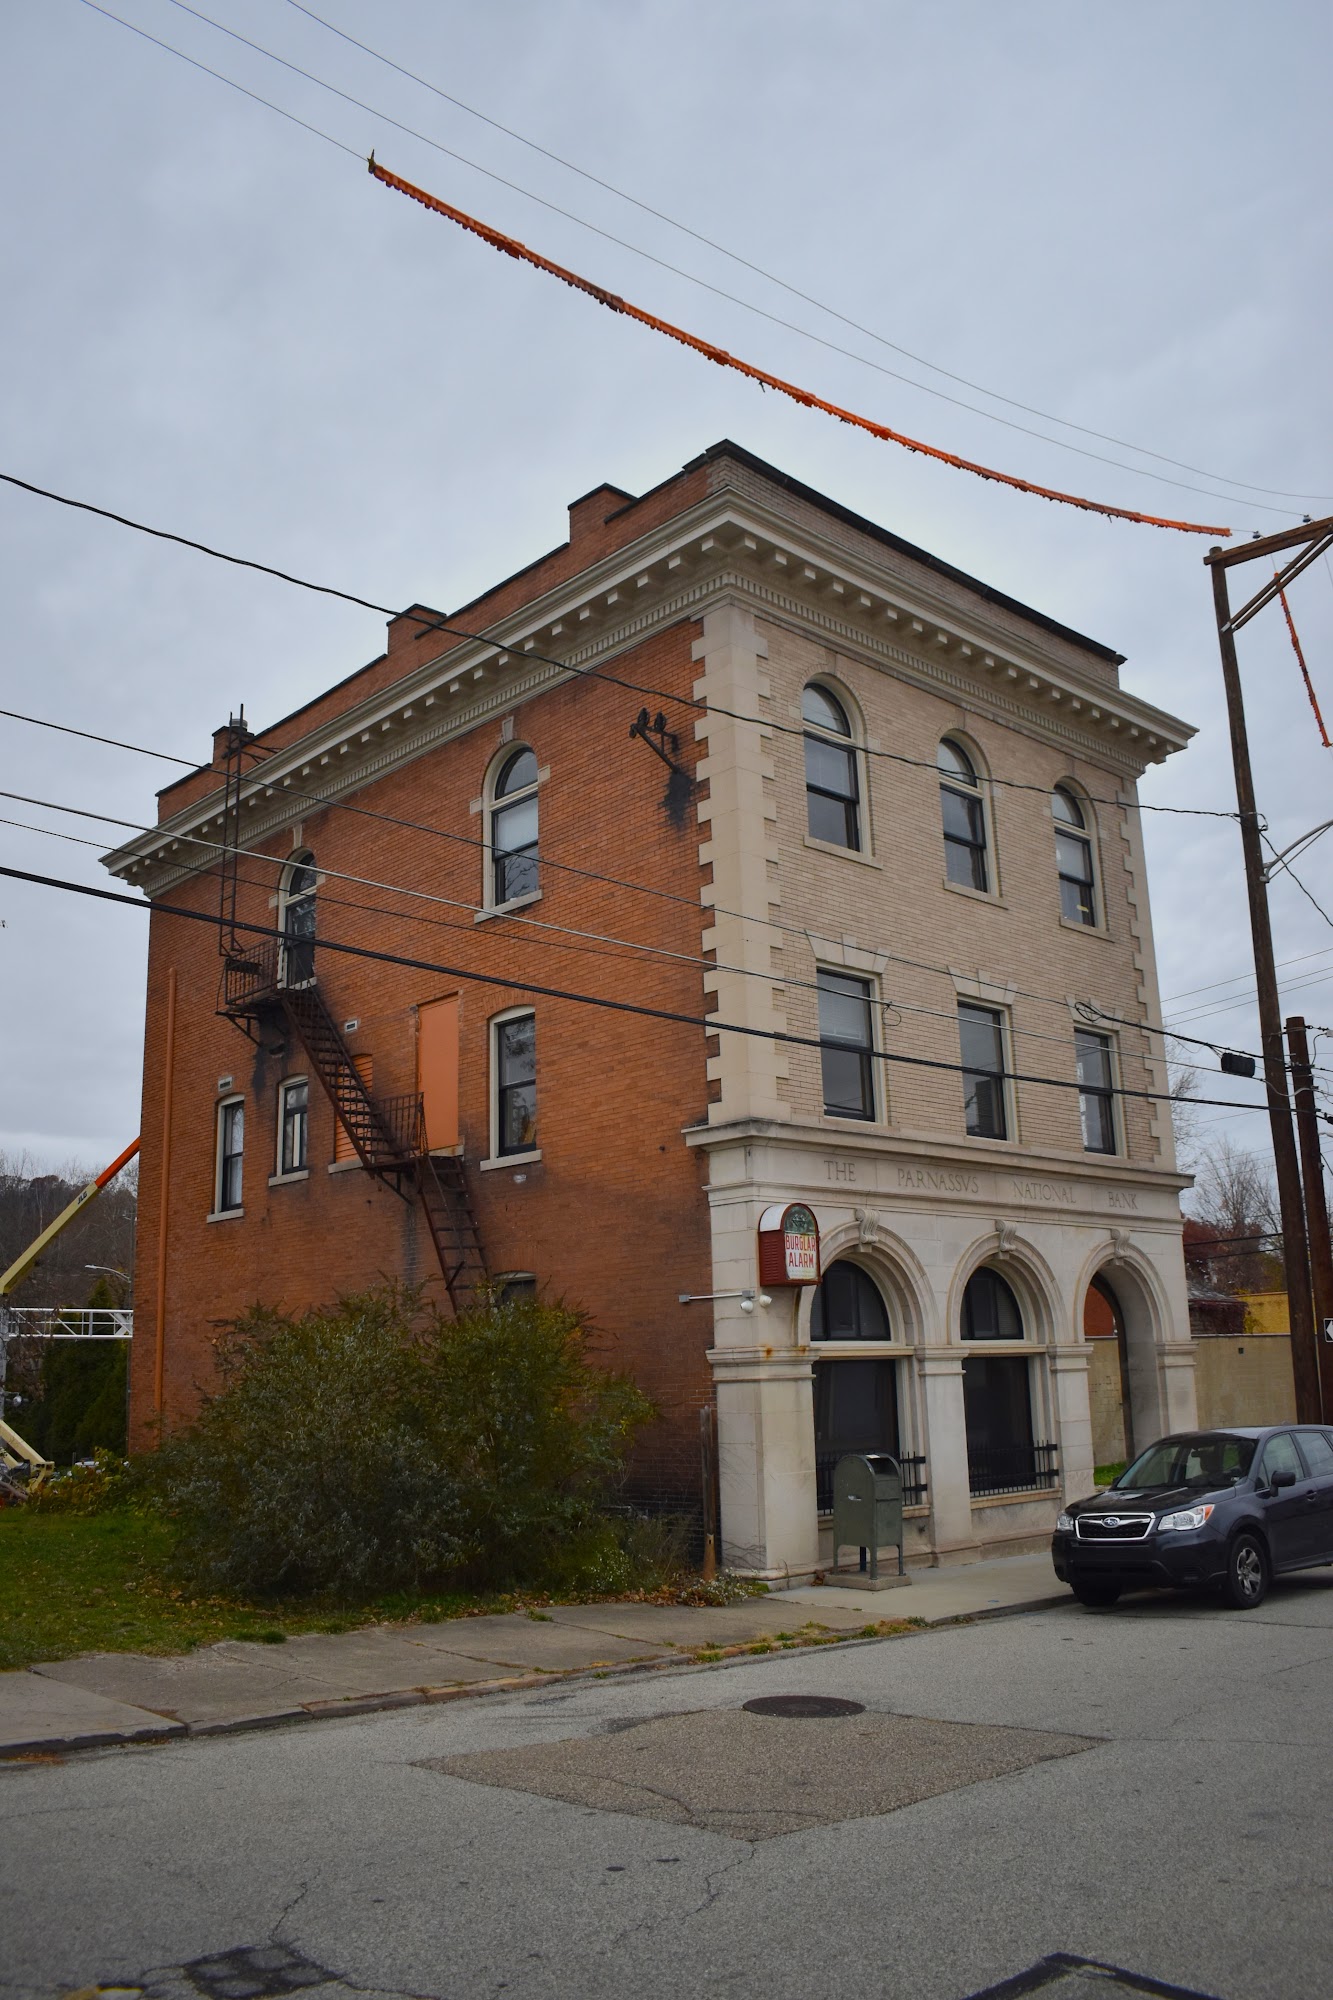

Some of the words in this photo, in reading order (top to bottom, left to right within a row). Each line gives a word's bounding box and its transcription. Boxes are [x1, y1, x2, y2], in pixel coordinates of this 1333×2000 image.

[823, 1160, 857, 1182] THE
[897, 1168, 979, 1194] PARNASSVS
[1013, 1181, 1077, 1204] NATIONAL
[1107, 1191, 1139, 1210] BANK
[785, 1234, 816, 1252] BURGLAR
[788, 1252, 814, 1268] ALARM
